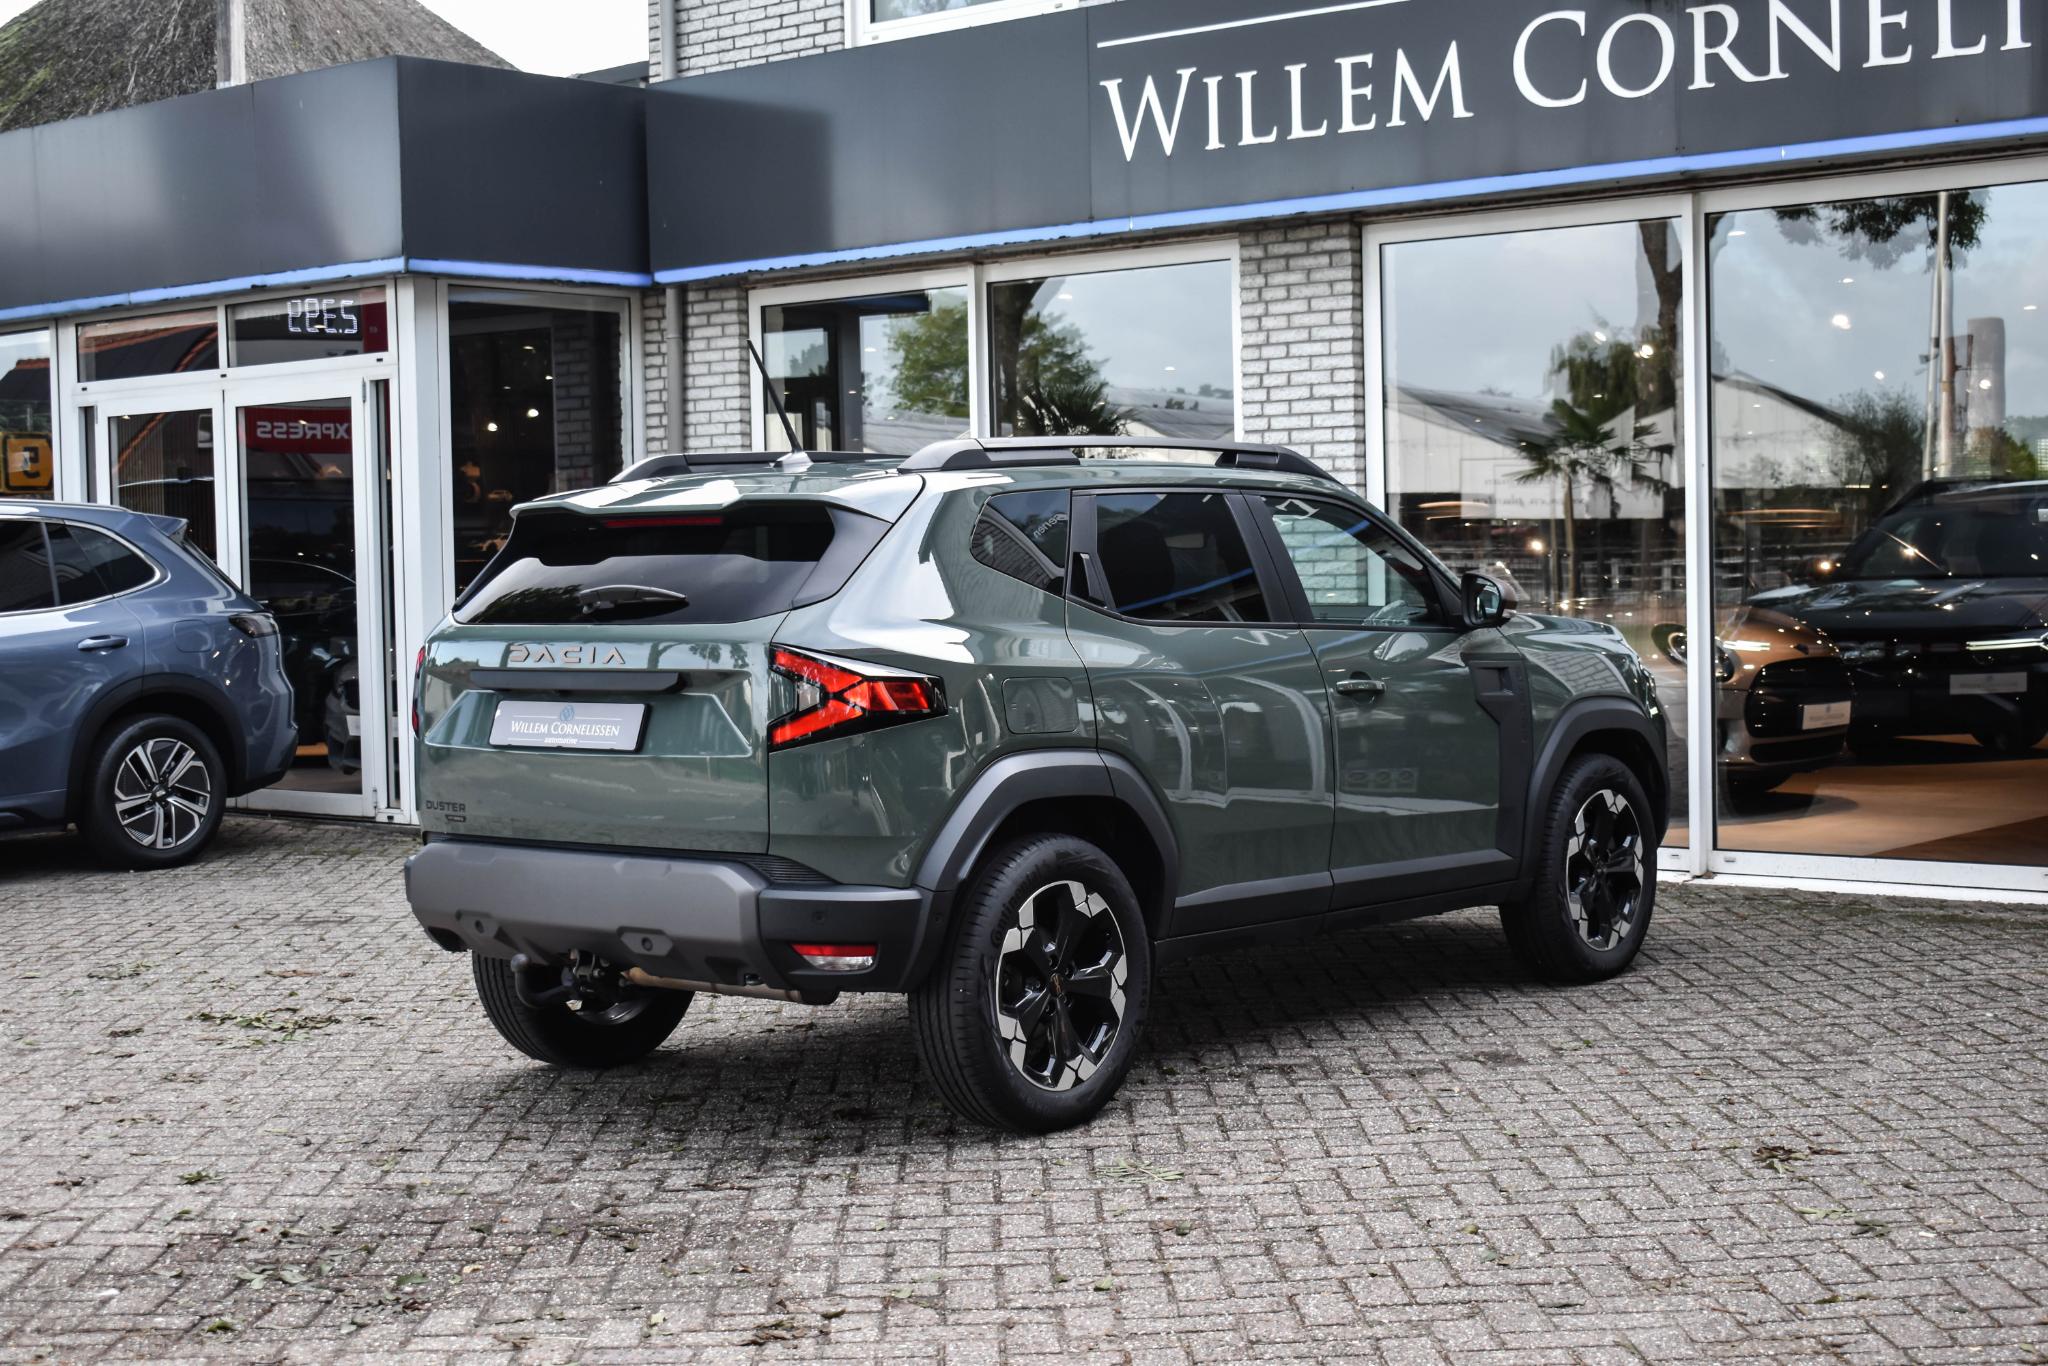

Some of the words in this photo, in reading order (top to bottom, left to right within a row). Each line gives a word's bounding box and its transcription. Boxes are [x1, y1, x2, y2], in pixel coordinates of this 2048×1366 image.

[1098, 38, 1475, 163] WILLEM
[509, 645, 626, 665] DACIA
[511, 720, 549, 735] WILLEM
[551, 721, 621, 736] CORNELISSEN
[426, 800, 466, 812] DUSTER
